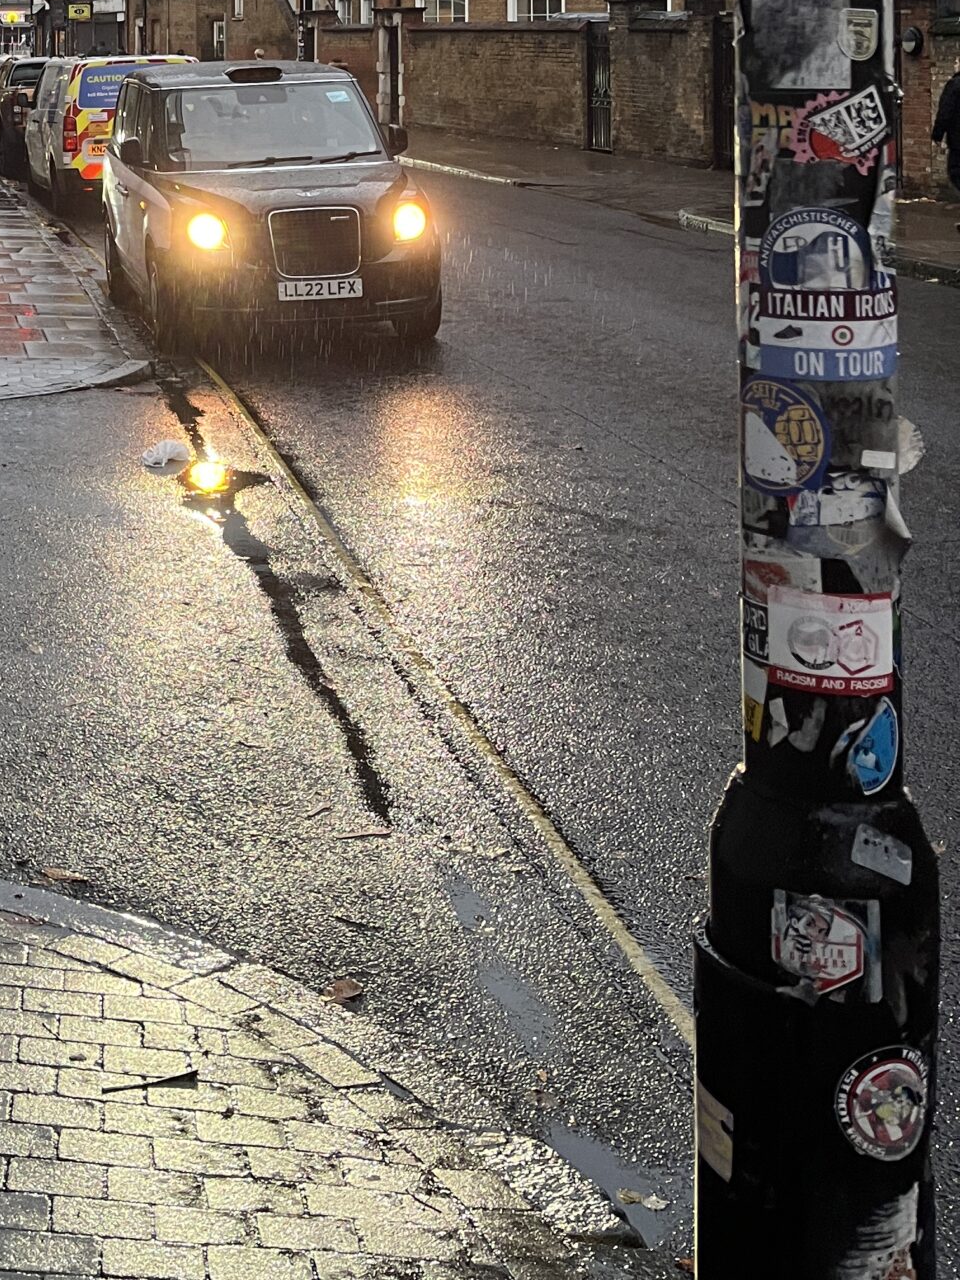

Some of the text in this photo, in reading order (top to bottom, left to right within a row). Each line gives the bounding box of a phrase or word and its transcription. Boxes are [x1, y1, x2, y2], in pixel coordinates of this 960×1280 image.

[760, 211, 859, 268] ANTIFASCHISTISCHER
[284, 280, 357, 297] LL22 LFX
[767, 290, 895, 318] ITALIAN IRONS
[794, 351, 884, 377] ON TOUR
[776, 670, 888, 691] RACISM AND FASCISM
